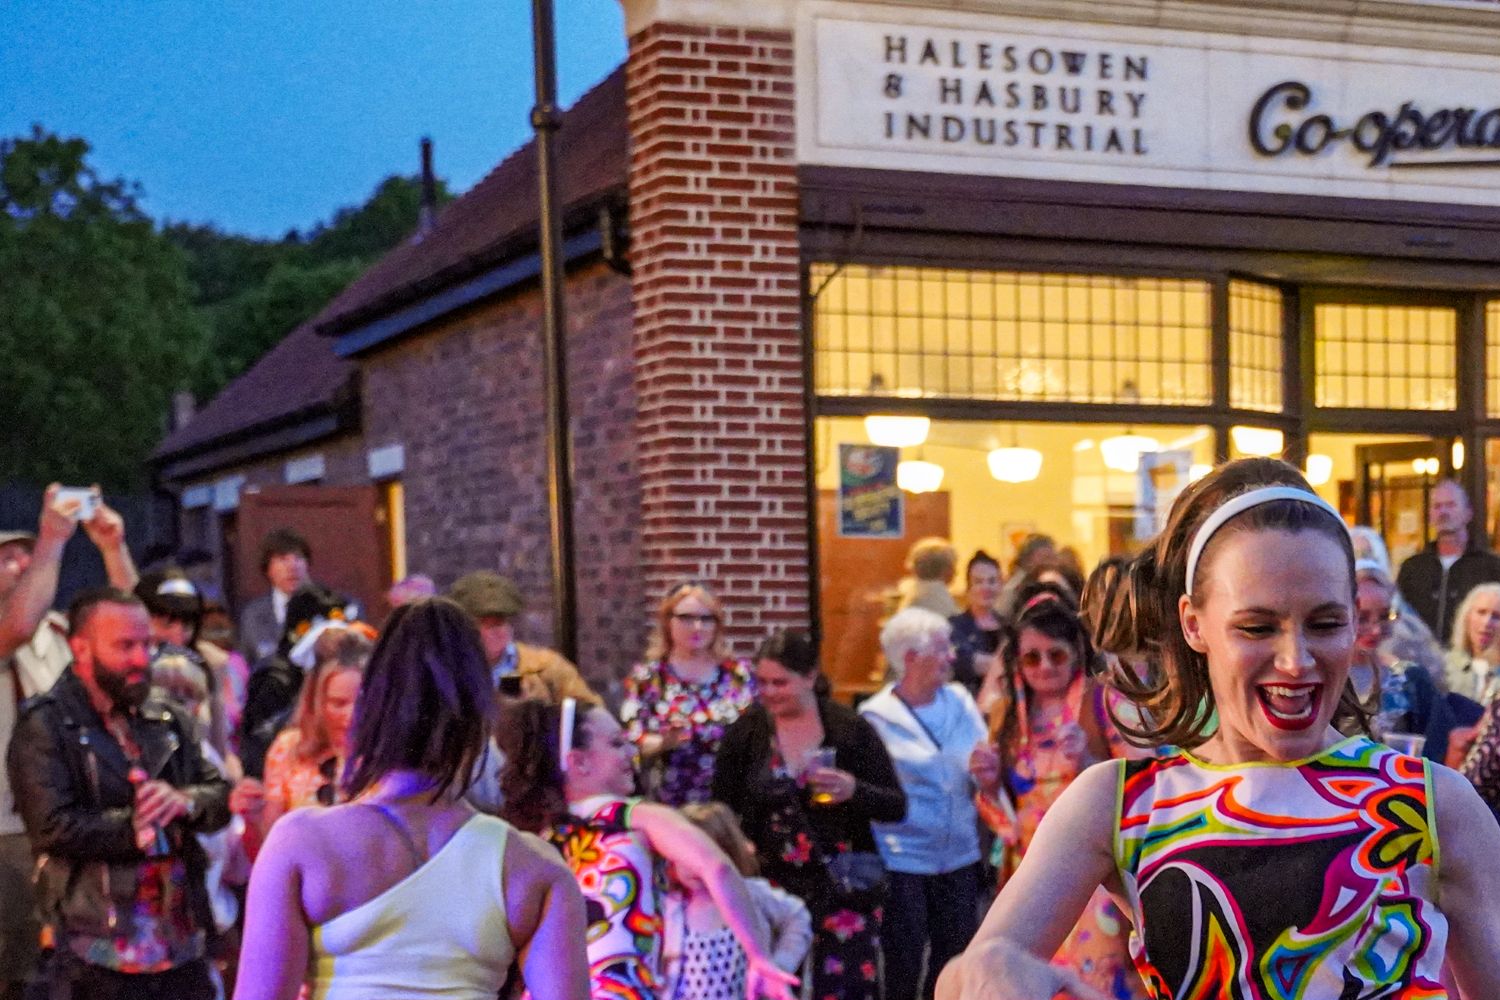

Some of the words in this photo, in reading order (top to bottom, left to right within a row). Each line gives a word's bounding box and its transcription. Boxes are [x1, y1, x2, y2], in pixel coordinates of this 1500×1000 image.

[884, 35, 1149, 81] HALESOWEN
[884, 73, 903, 98] &
[940, 77, 1146, 118] HASBURY
[884, 112, 1149, 155] INDUSTRIAL
